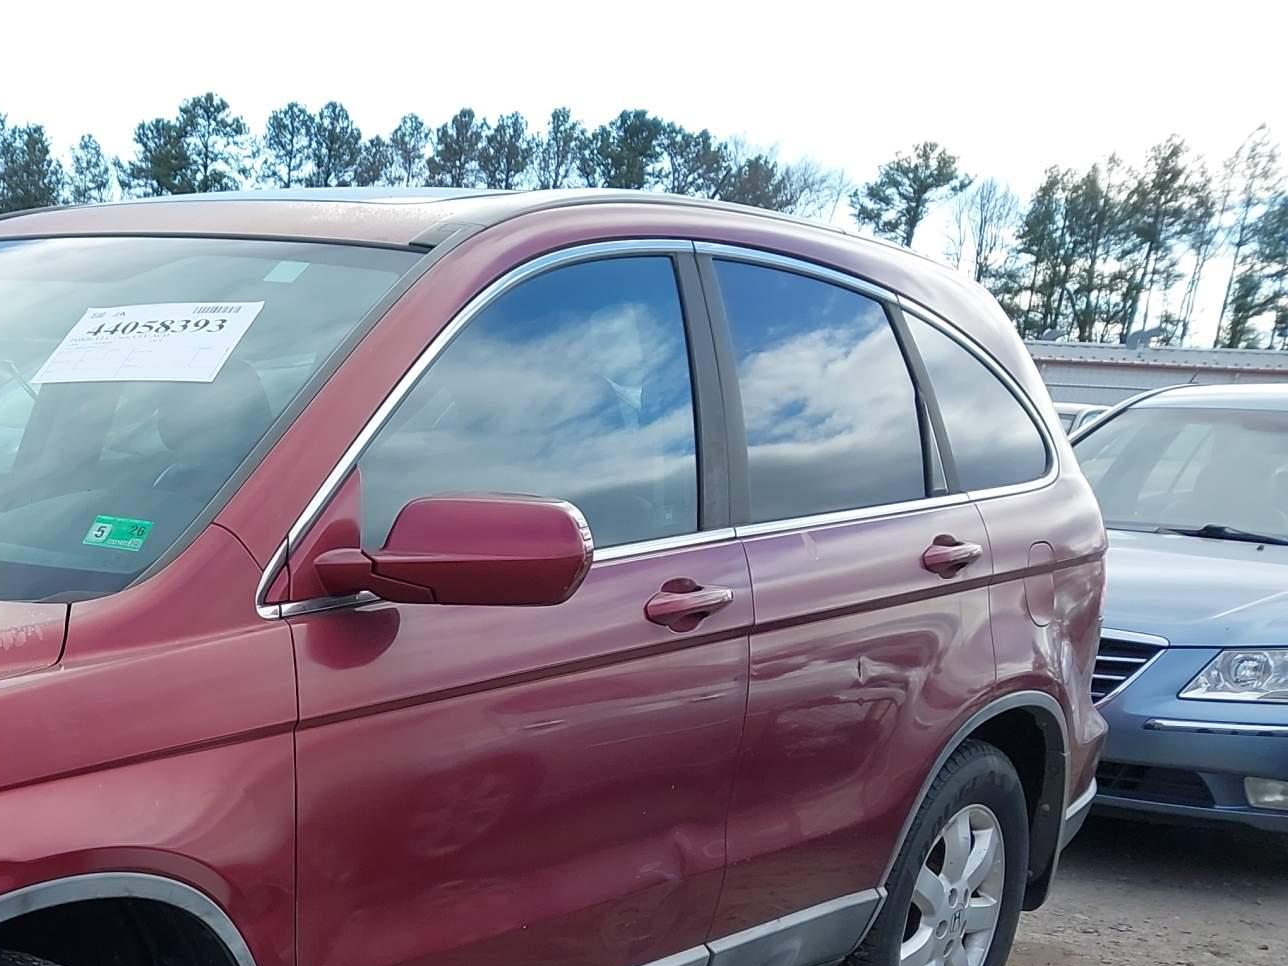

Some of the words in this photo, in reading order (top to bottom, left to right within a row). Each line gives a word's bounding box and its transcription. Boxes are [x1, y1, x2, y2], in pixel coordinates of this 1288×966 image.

[87, 318, 228, 336] 44058393
[94, 525, 107, 539] 5
[128, 524, 146, 537] 26
